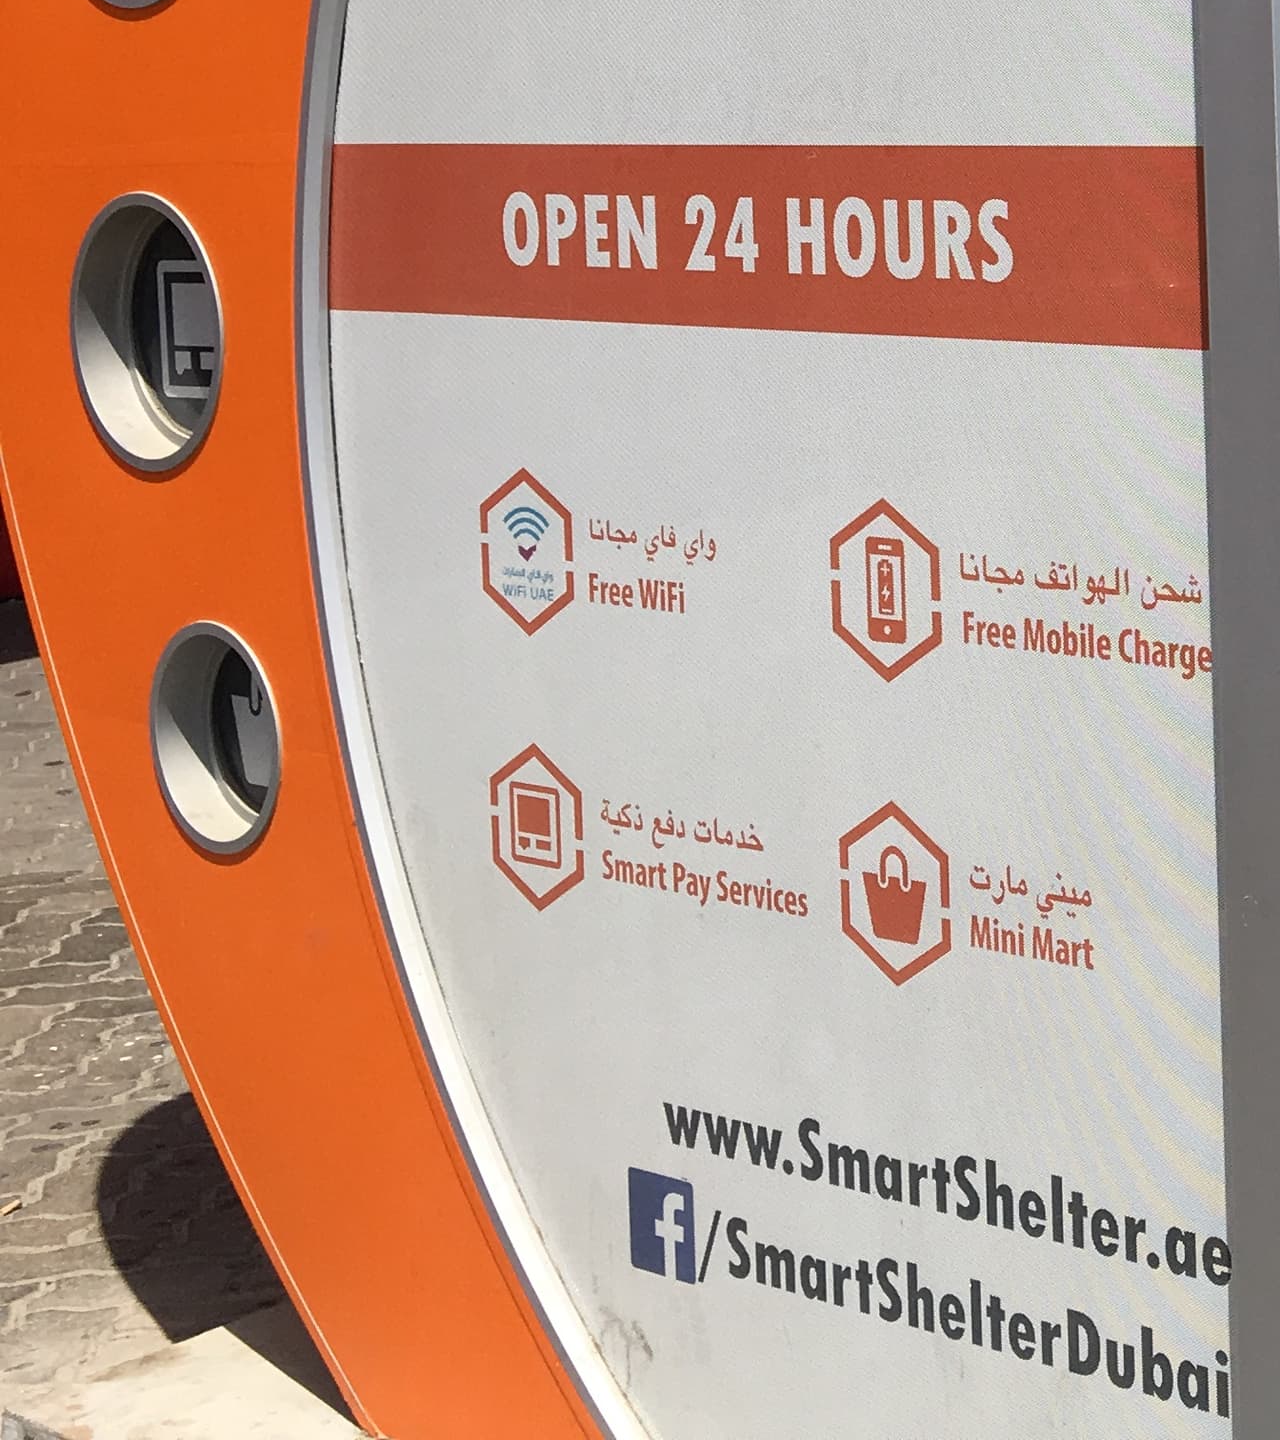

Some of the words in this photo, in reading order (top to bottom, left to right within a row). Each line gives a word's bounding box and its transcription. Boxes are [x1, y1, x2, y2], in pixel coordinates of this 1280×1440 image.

[502, 191, 659, 271] OPEN
[684, 194, 760, 273] 24
[785, 196, 1014, 283] HOURS
[588, 517, 638, 550] مجانا
[644, 525, 677, 563] فاي
[683, 529, 718, 566] واي
[588, 572, 634, 608] Free
[638, 577, 685, 614] WiFi
[958, 552, 1026, 594] مجانا
[1034, 561, 1130, 606] الهواتف
[1140, 573, 1204, 611] شحن
[530, 587, 554, 602] UAE
[962, 610, 1017, 650] Free
[1023, 617, 1113, 661] Mobile
[1117, 627, 1214, 681] Charge
[600, 798, 644, 836] ذكية
[651, 808, 687, 849] دفع
[693, 817, 765, 852] خدمات
[602, 848, 668, 892] Smart
[673, 861, 712, 908] Pay
[716, 870, 809, 918] Services
[969, 864, 1029, 906] مارت
[1035, 872, 1093, 920] ميني
[970, 914, 1026, 958] Mini
[1031, 925, 1095, 971] Mart
[662, 1101, 1232, 1287] www.SmartShelter.ae
